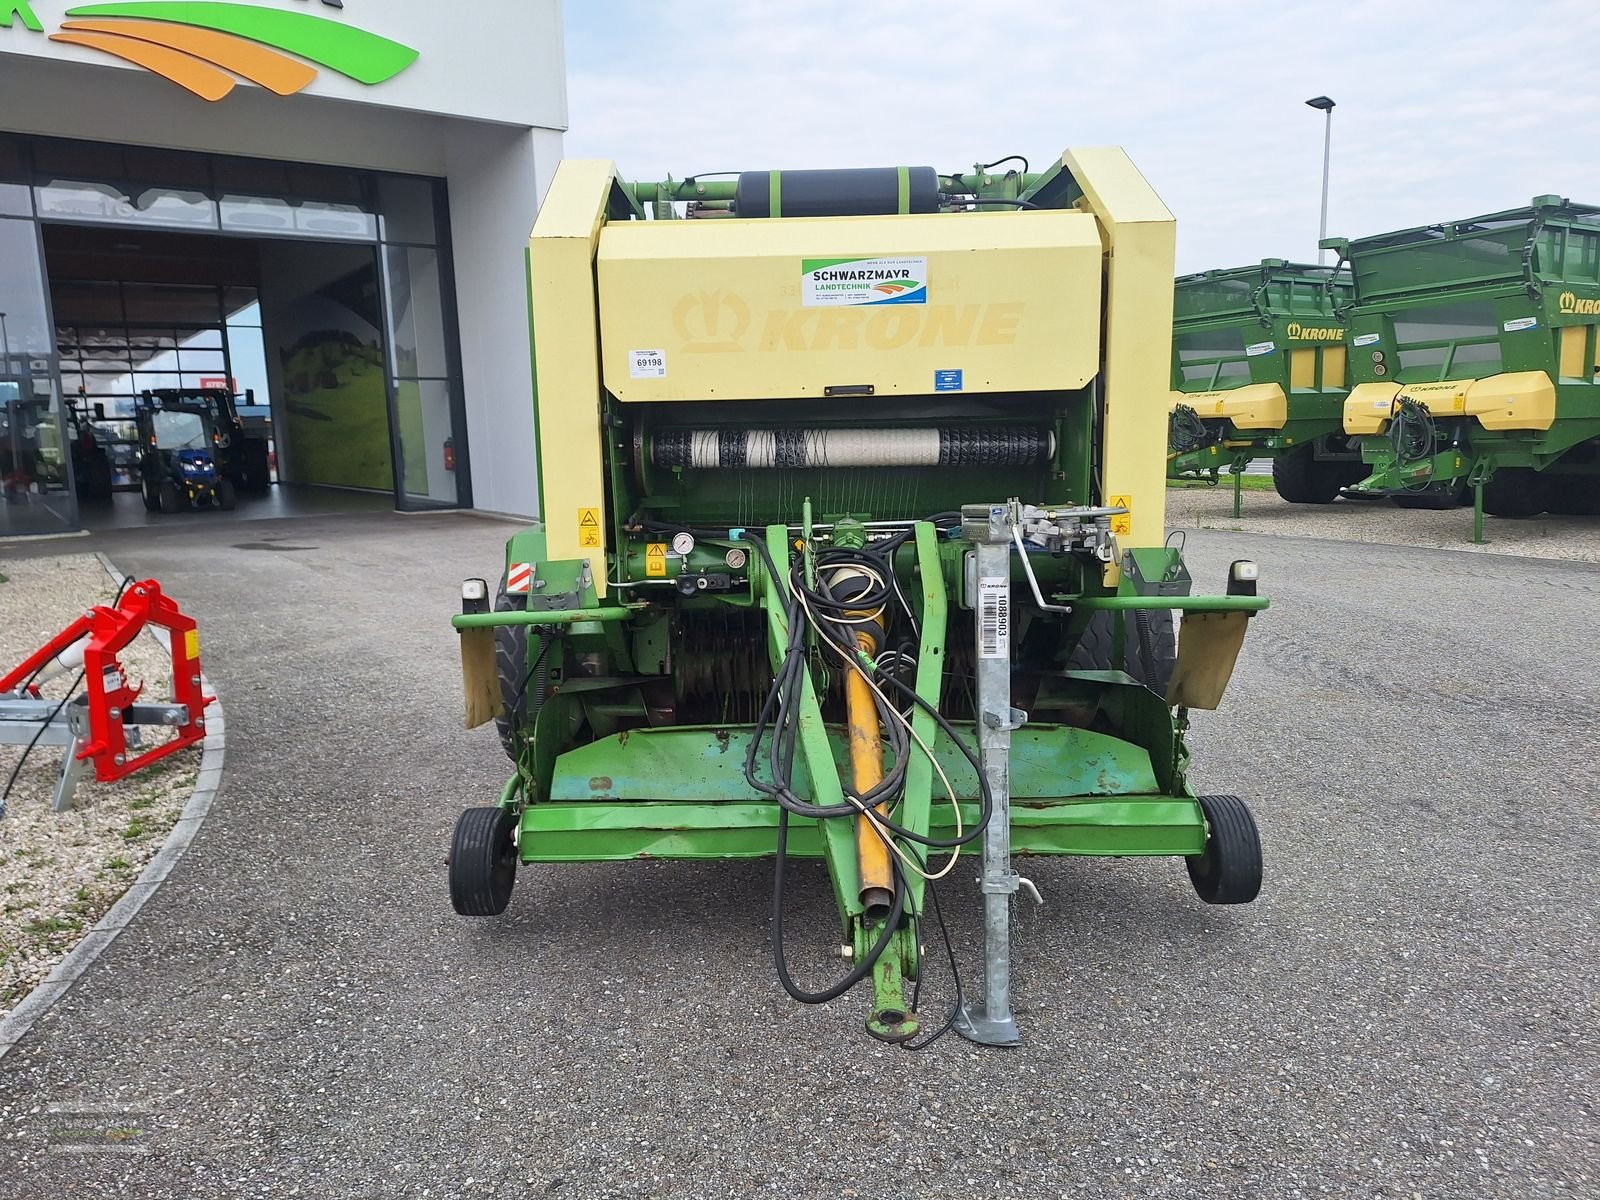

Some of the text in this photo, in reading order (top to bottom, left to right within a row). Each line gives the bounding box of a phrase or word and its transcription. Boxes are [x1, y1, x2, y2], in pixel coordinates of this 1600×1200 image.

[813, 269, 910, 281] SCHWARZMAYR
[815, 283, 871, 291] LANDTECHNIK
[759, 303, 1025, 352] KRONE
[1300, 327, 1344, 341] KRONE
[637, 358, 662, 367] 69198
[1420, 384, 1458, 392] KRONE
[997, 594, 1007, 636] 1088903
